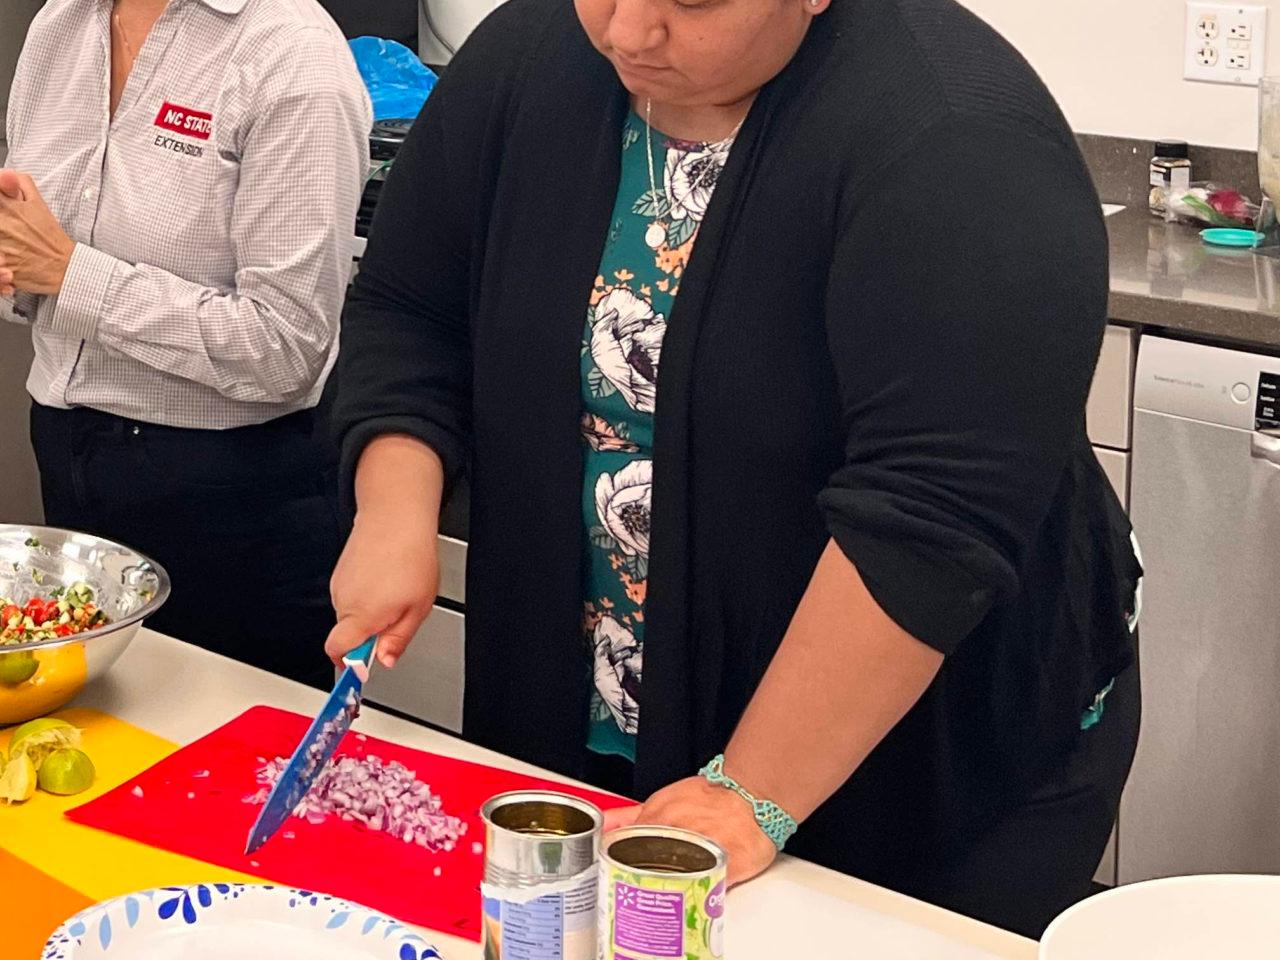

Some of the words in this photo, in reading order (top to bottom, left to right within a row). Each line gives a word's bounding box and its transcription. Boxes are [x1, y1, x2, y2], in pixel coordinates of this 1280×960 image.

[164, 109, 184, 126] NC
[184, 115, 212, 133] STATE
[154, 135, 203, 157] EXTENSION
